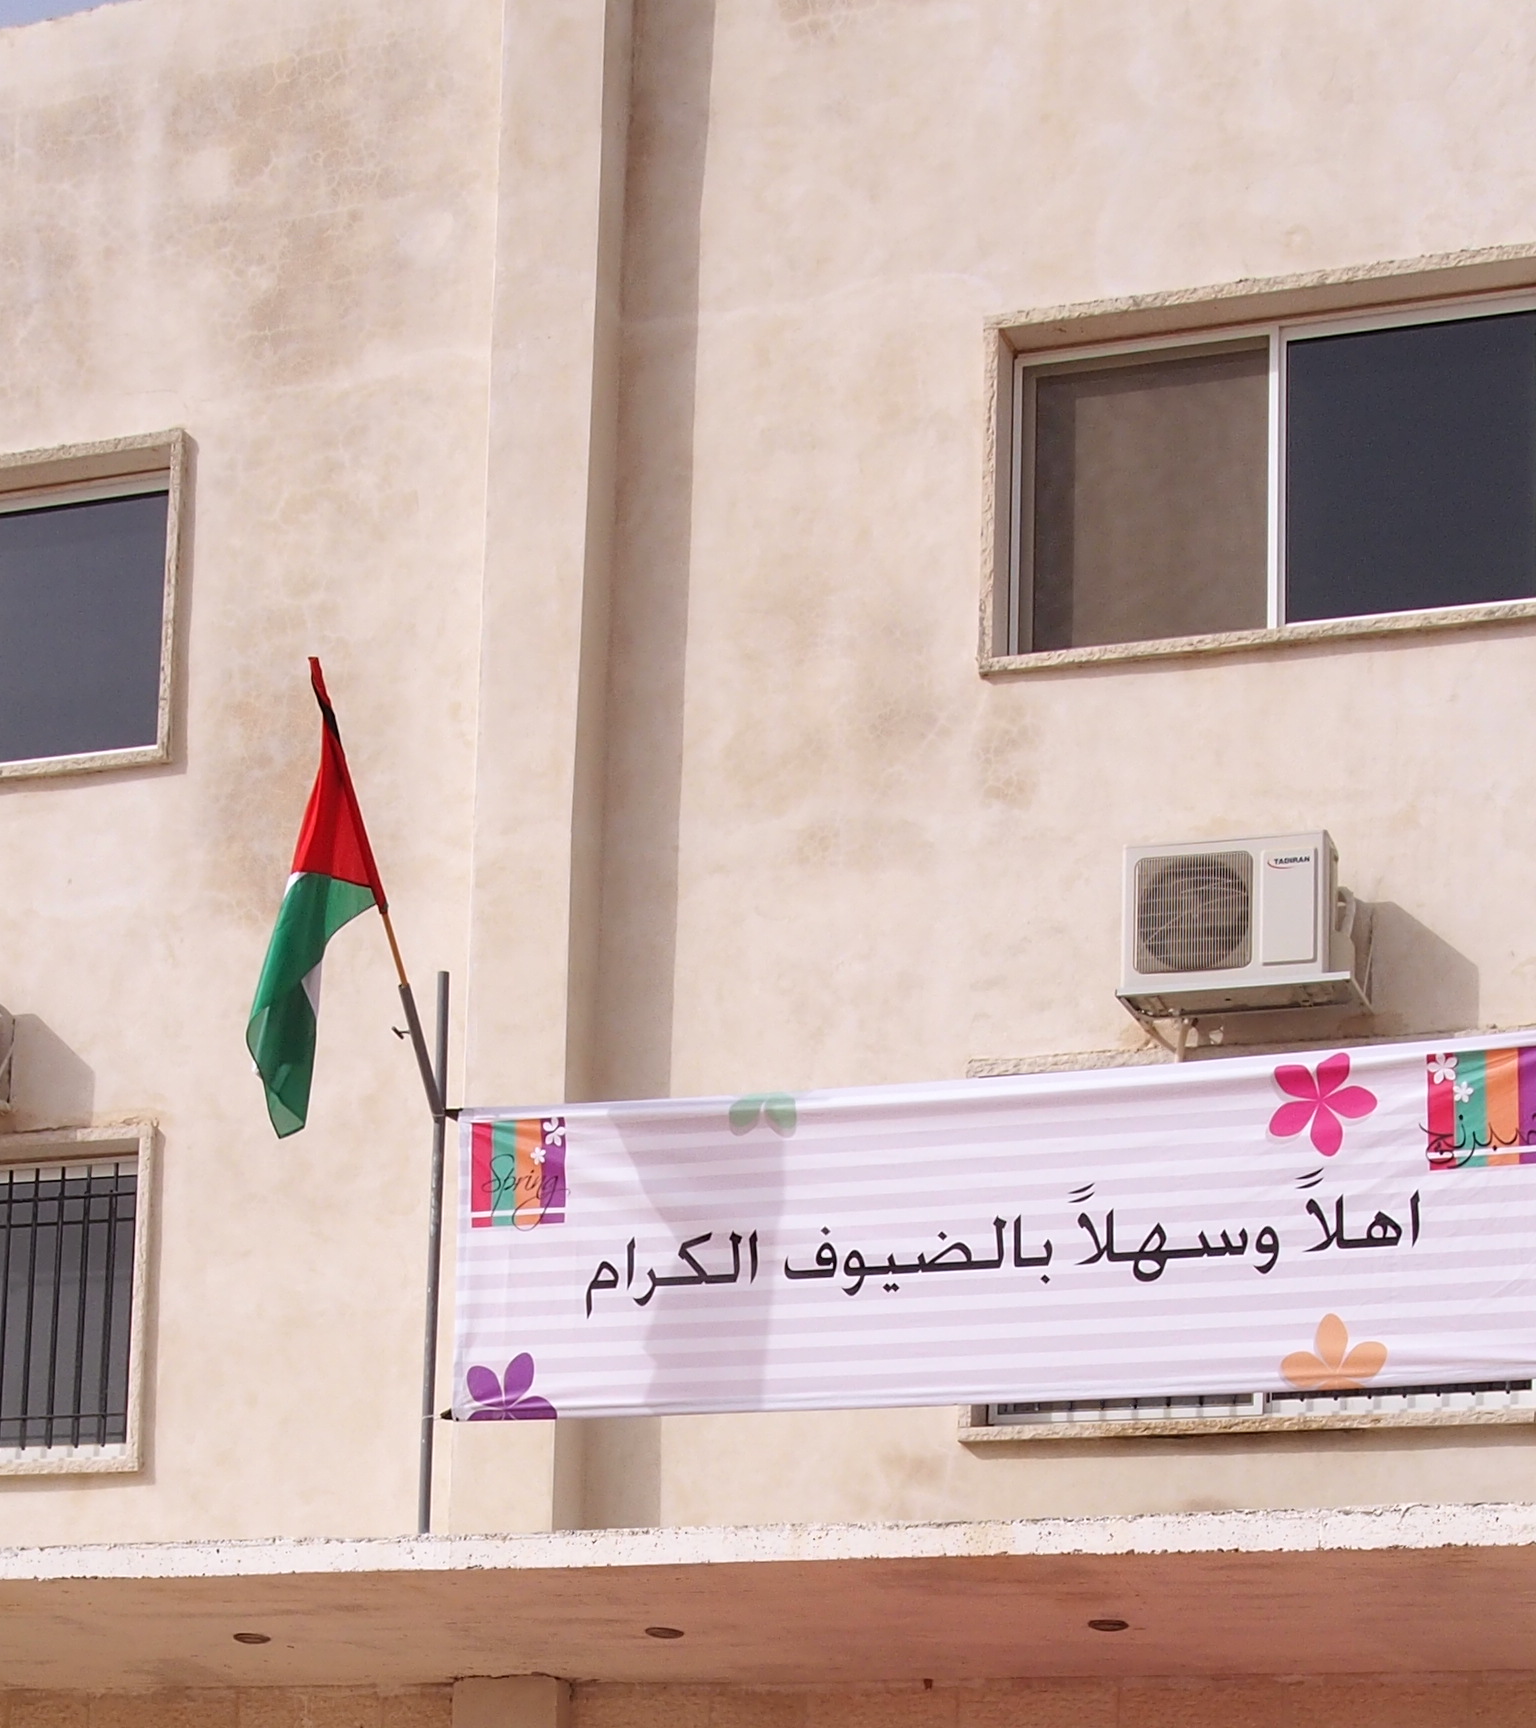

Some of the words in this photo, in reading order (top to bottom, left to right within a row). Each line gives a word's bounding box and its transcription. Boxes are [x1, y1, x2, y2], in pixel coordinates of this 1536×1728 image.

[480, 1153, 572, 1232] Spring
[1066, 1182, 1281, 1283] وسهلاً
[1294, 1167, 1421, 1253] اهلاً
[585, 1229, 759, 1319] الكرام
[783, 1213, 1054, 1297] بالضيوف
